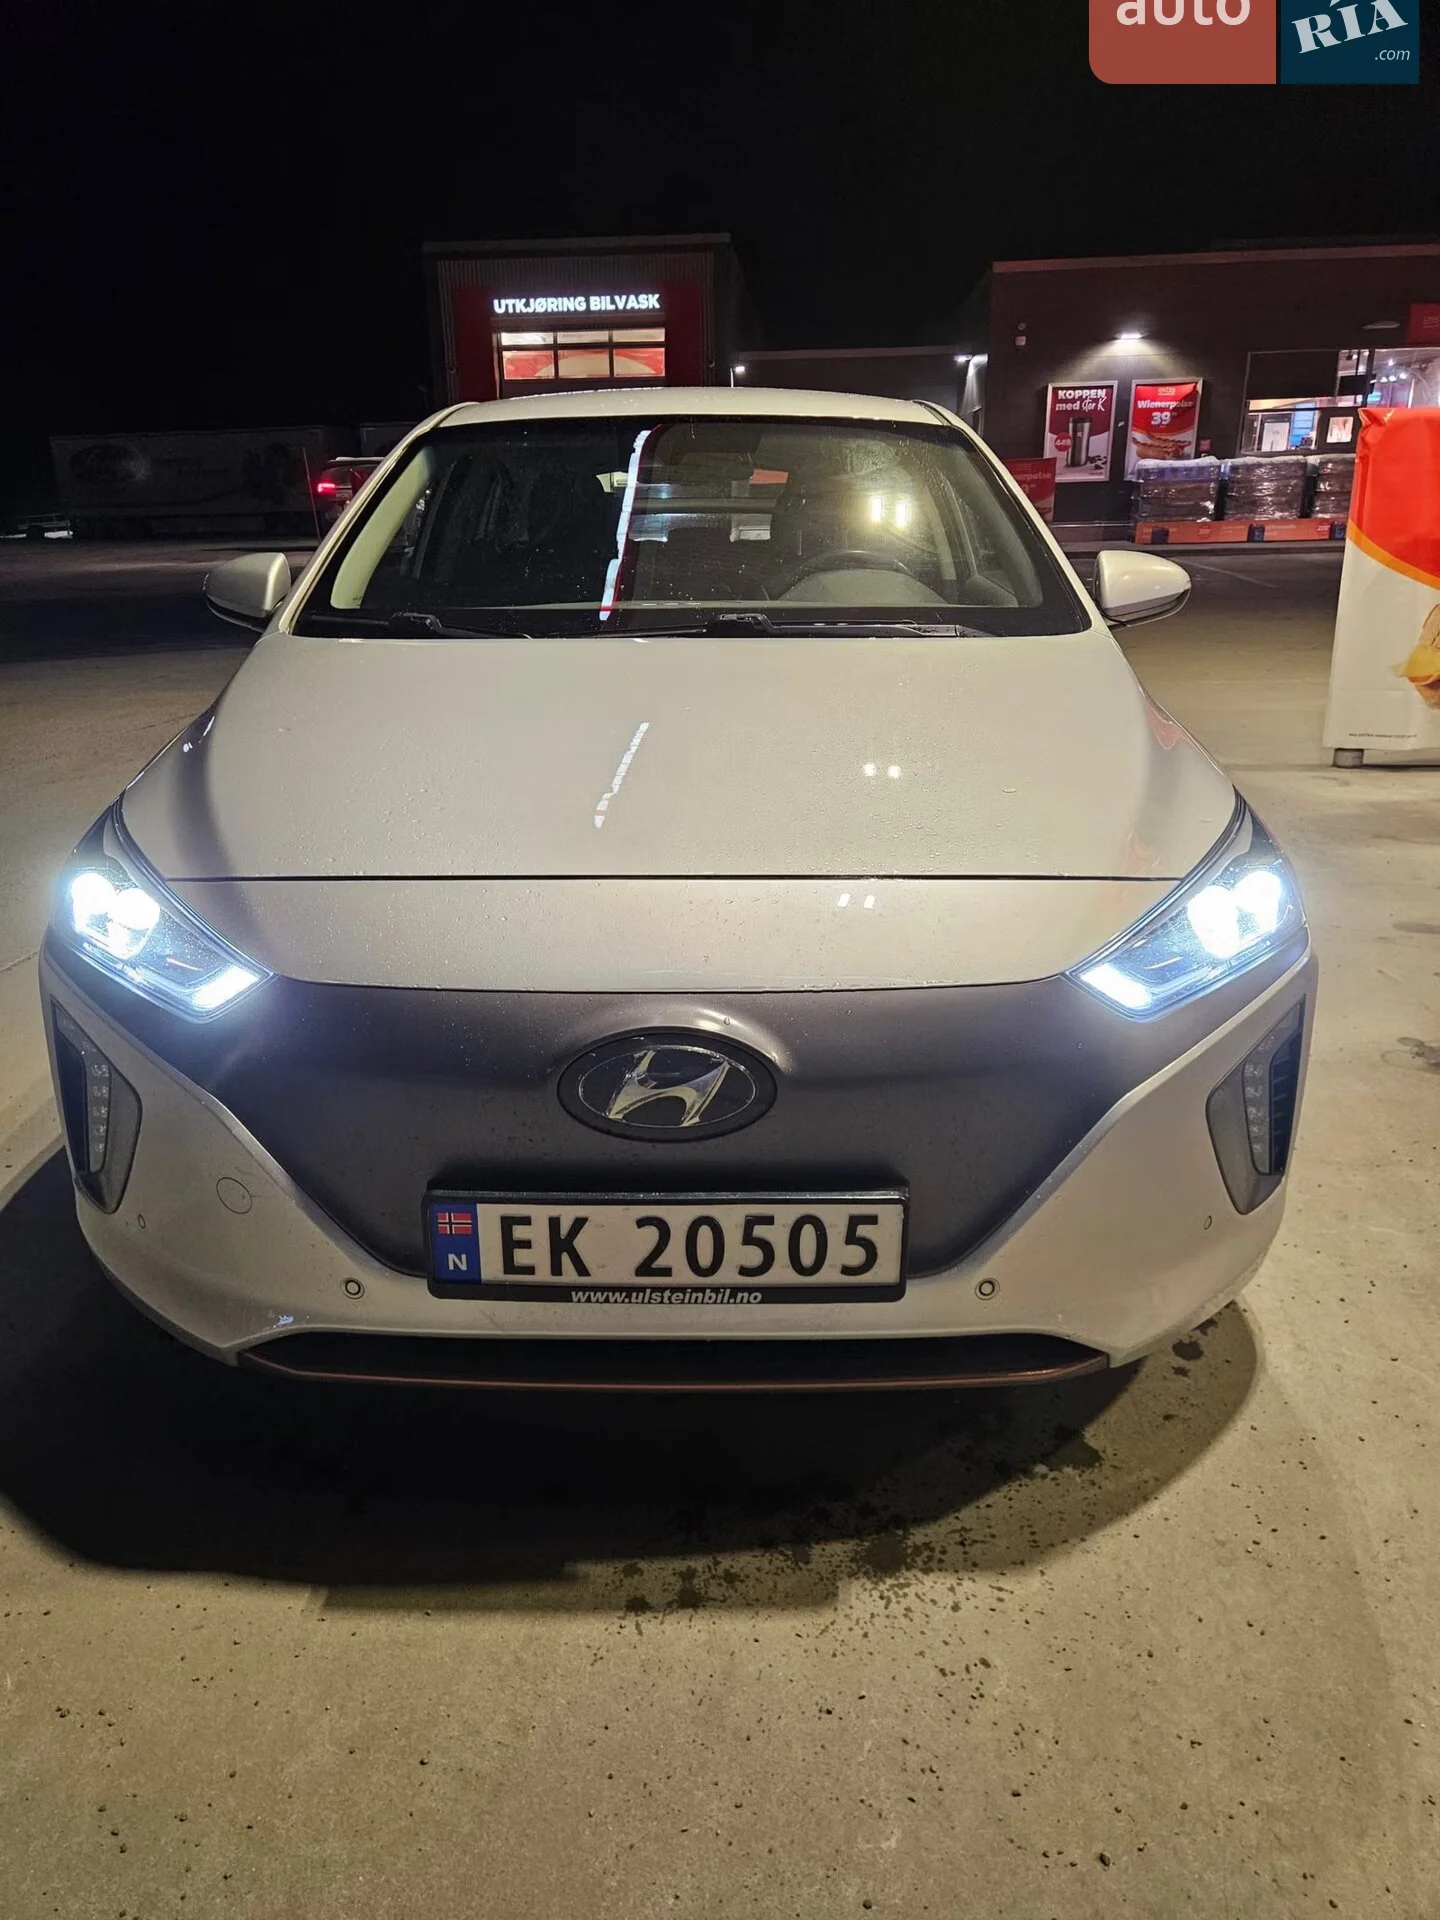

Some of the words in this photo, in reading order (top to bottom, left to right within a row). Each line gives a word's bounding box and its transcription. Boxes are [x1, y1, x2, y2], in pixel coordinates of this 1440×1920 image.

[493, 297, 587, 314] UTKJØRING
[589, 294, 660, 311] BILVASK
[1057, 388, 1107, 400] KOPPEN
[1055, 401, 1080, 411] med
[1096, 396, 1107, 411] K
[1151, 411, 1171, 425] 39
[501, 1215, 592, 1277] EK
[634, 1214, 878, 1278] 20505
[448, 1253, 468, 1271] N
[571, 1288, 762, 1304] www.ulsteinbil.no
